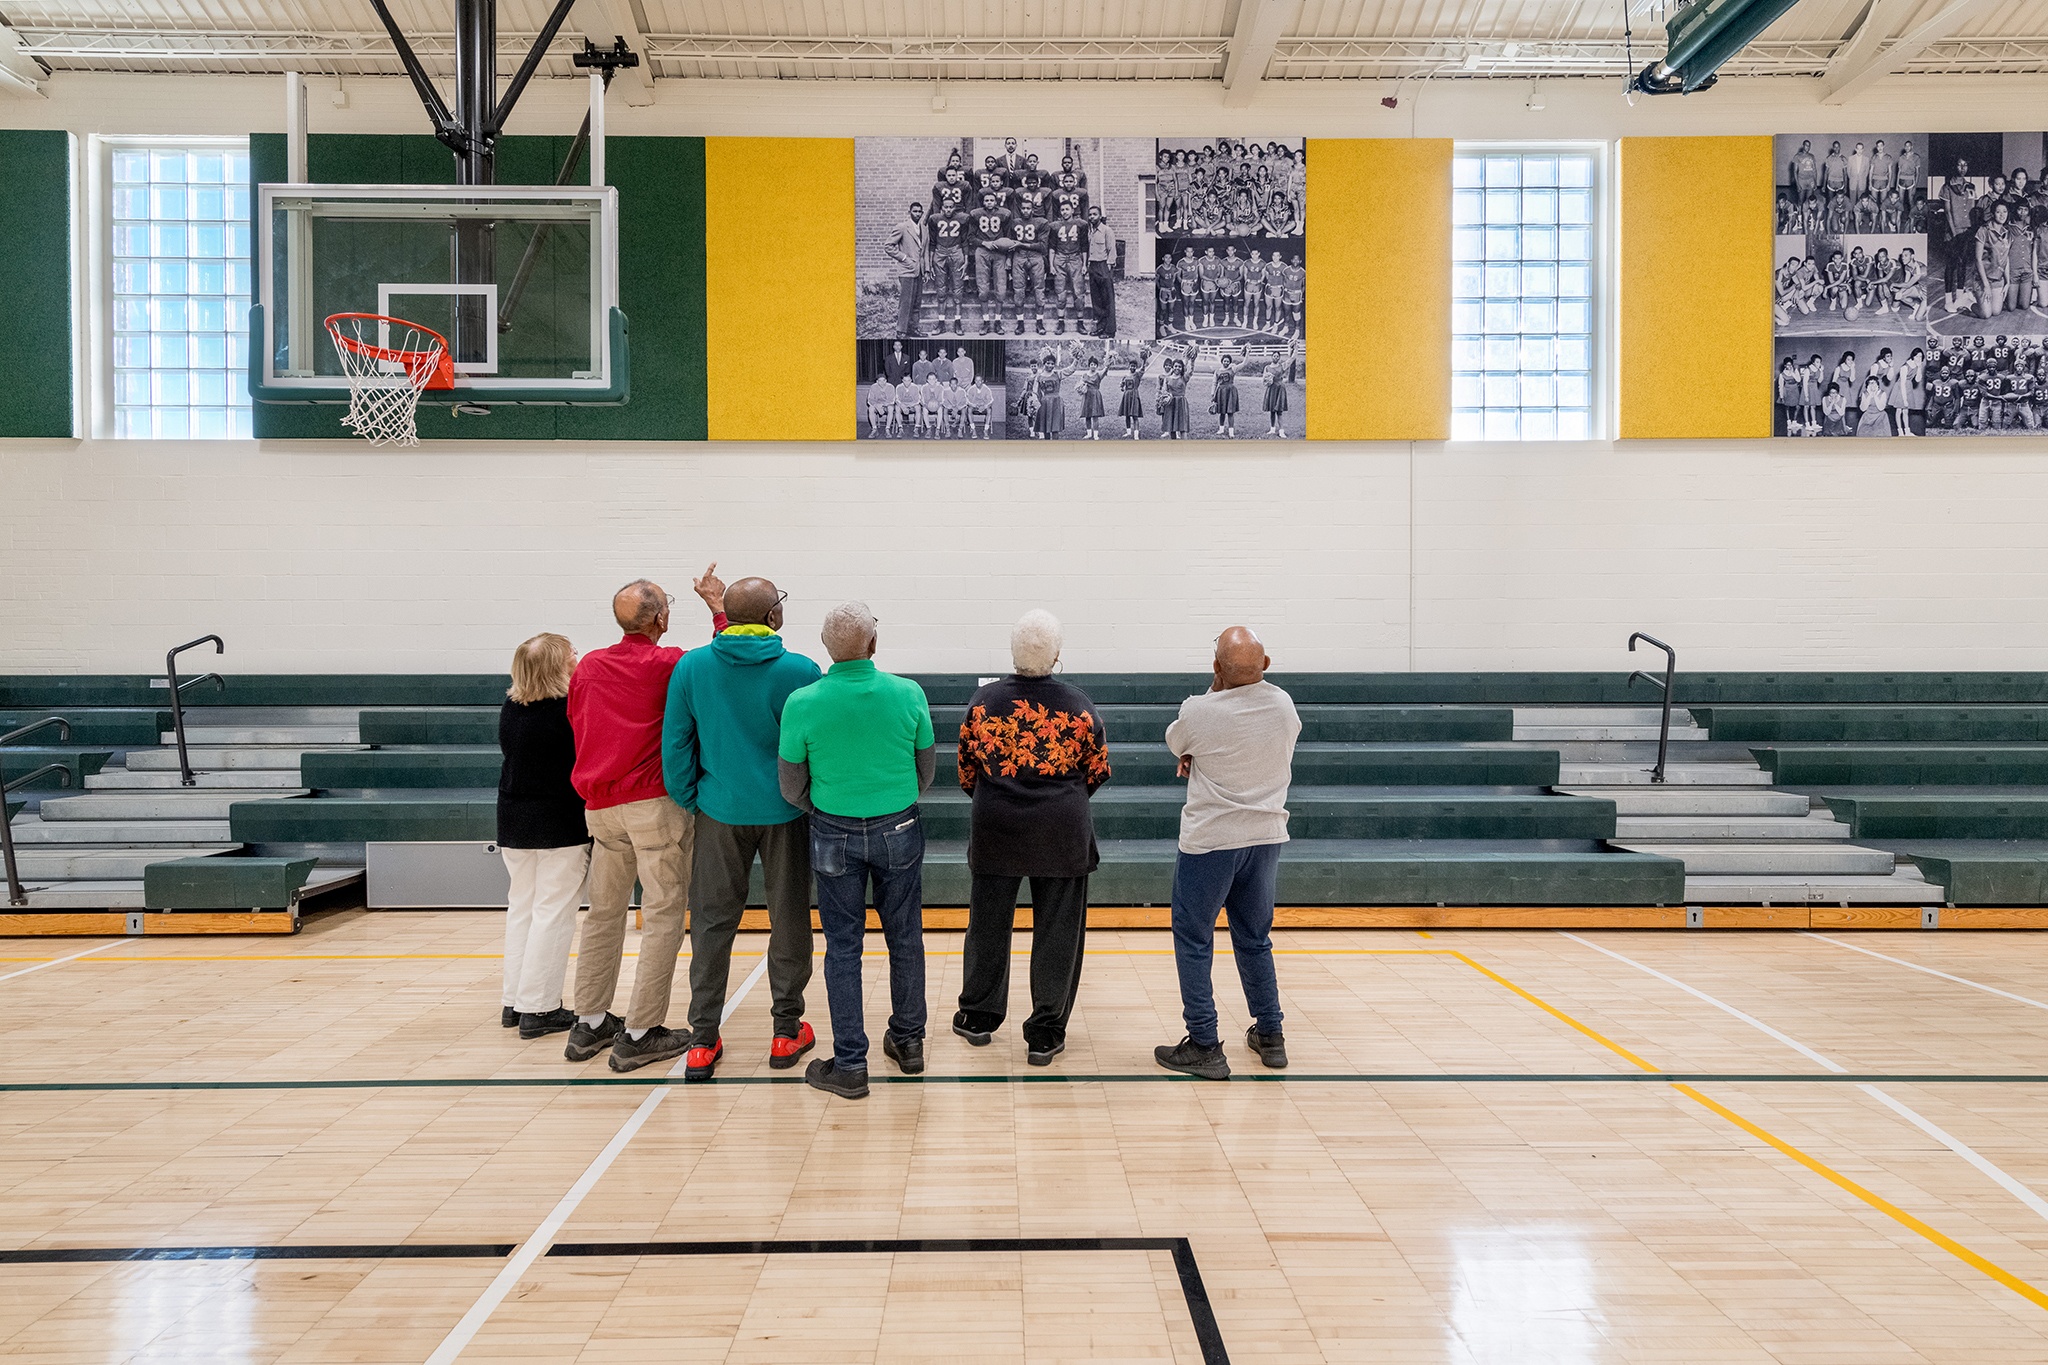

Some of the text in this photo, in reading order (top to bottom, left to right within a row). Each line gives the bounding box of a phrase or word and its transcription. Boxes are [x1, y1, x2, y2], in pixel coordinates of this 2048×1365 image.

[937, 220, 961, 237] 22
[978, 216, 1001, 233] 88
[1014, 224, 1036, 241] 33
[1057, 224, 1079, 242] 44
[1926, 350, 1941, 361] 88
[1971, 350, 1985, 361] 21
[1994, 347, 2009, 358] 66
[1948, 355, 1965, 368] 94
[1986, 378, 2002, 390] 33
[2010, 379, 2027, 391] 32
[1935, 385, 1951, 397] 93
